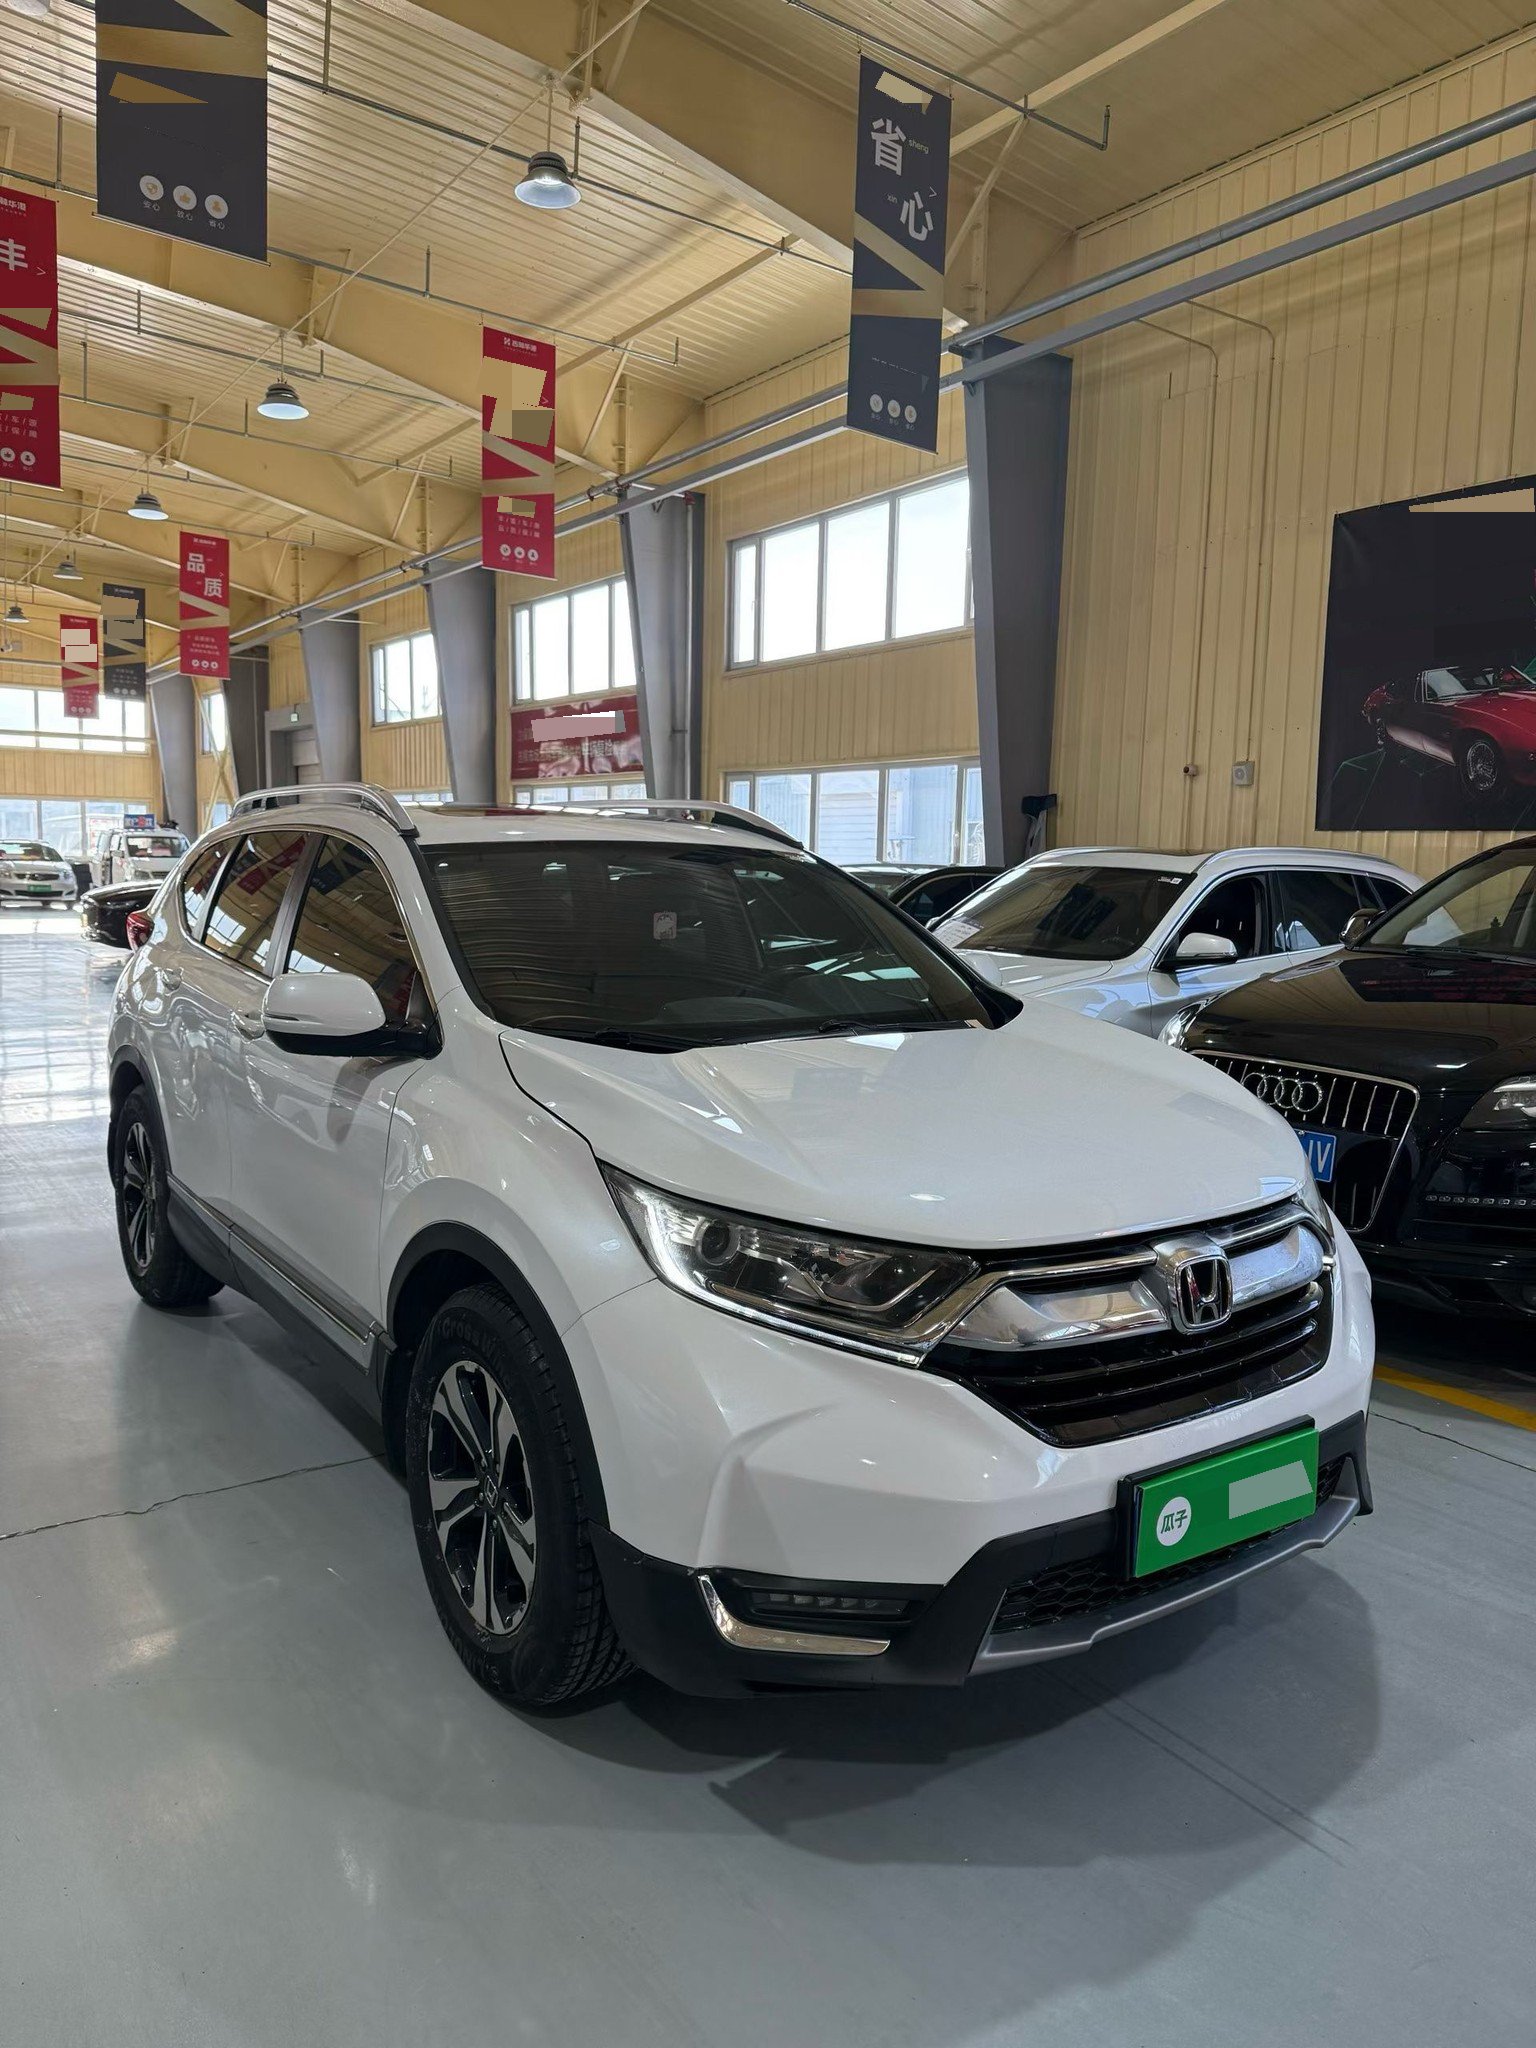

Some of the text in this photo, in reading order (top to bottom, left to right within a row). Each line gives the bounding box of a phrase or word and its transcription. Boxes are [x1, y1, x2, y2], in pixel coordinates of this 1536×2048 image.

[871, 118, 907, 176] 省
[908, 138, 930, 155] sheng
[900, 191, 934, 242] 心
[187, 553, 205, 574] 品
[204, 577, 222, 598] 质
[1160, 1508, 1188, 1534] 瓜子
